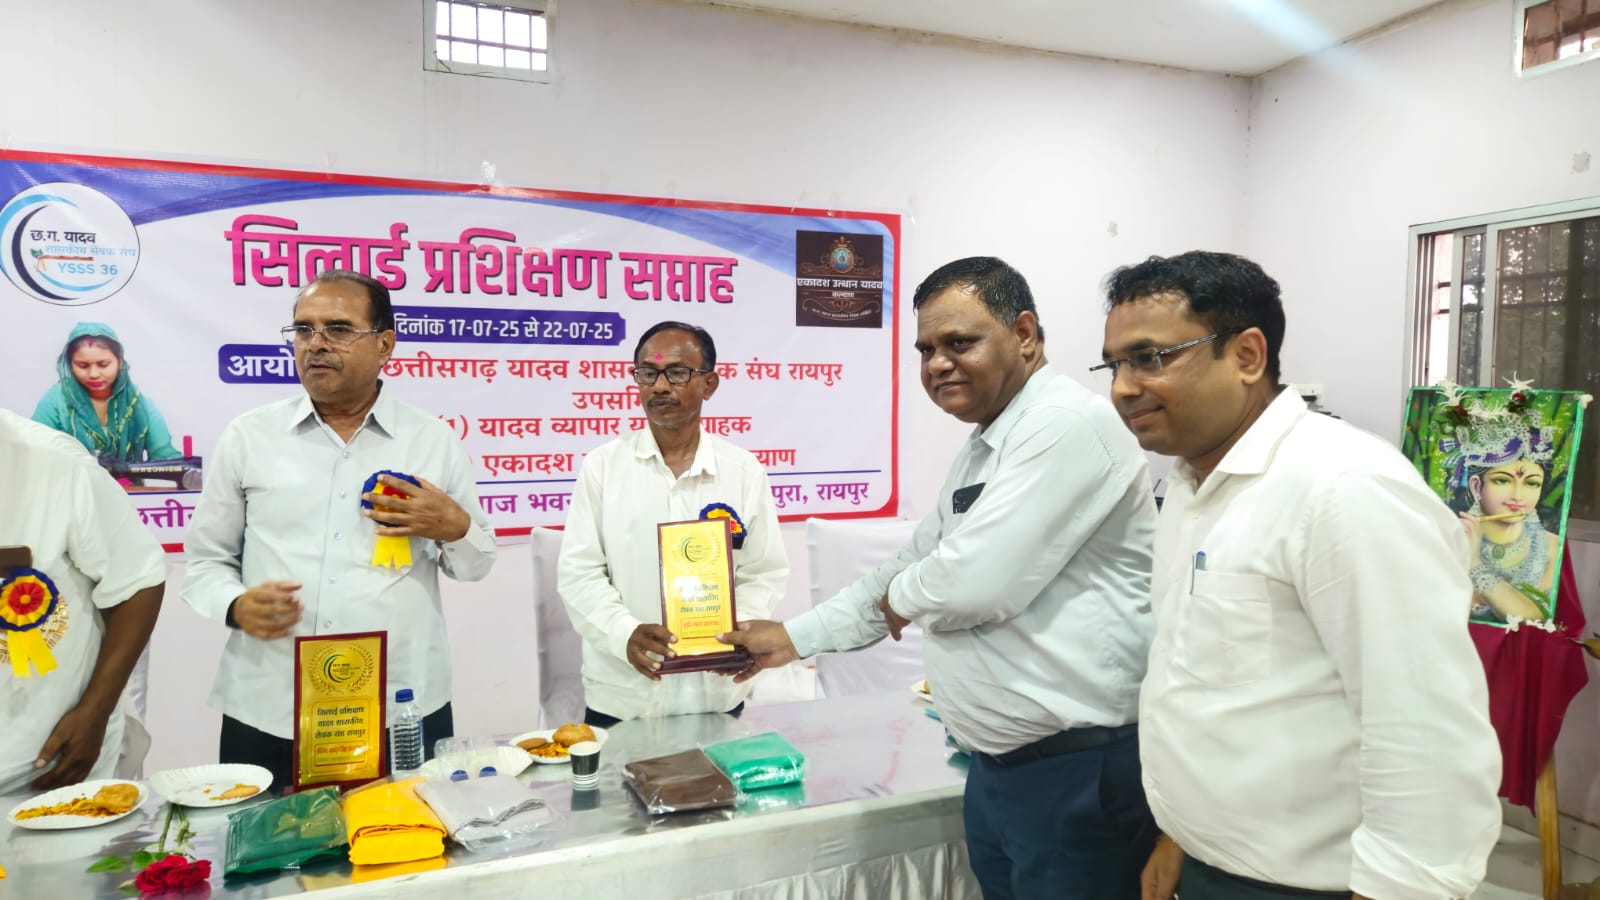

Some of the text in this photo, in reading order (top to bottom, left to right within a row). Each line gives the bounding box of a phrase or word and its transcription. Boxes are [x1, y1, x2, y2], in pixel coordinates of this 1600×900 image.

[30, 229, 96, 244] छ.ग. यादव
[58, 262, 119, 275] YSSS 36
[224, 213, 739, 304] सिलाई प्रशिक्षण सप्ताह
[797, 278, 831, 288] एकादश
[860, 280, 884, 290] यादव
[394, 312, 614, 340] दिनांक 17-07-25 से 22-07-25
[383, 350, 499, 384] छत्तीसगढ़
[506, 359, 570, 381] यादव
[745, 356, 782, 381] संघ
[788, 363, 843, 387] रायपुर
[478, 417, 543, 440] यादव
[550, 416, 622, 437] व्यापार
[481, 453, 575, 477] एकादश
[816, 482, 870, 505] रायपुर
